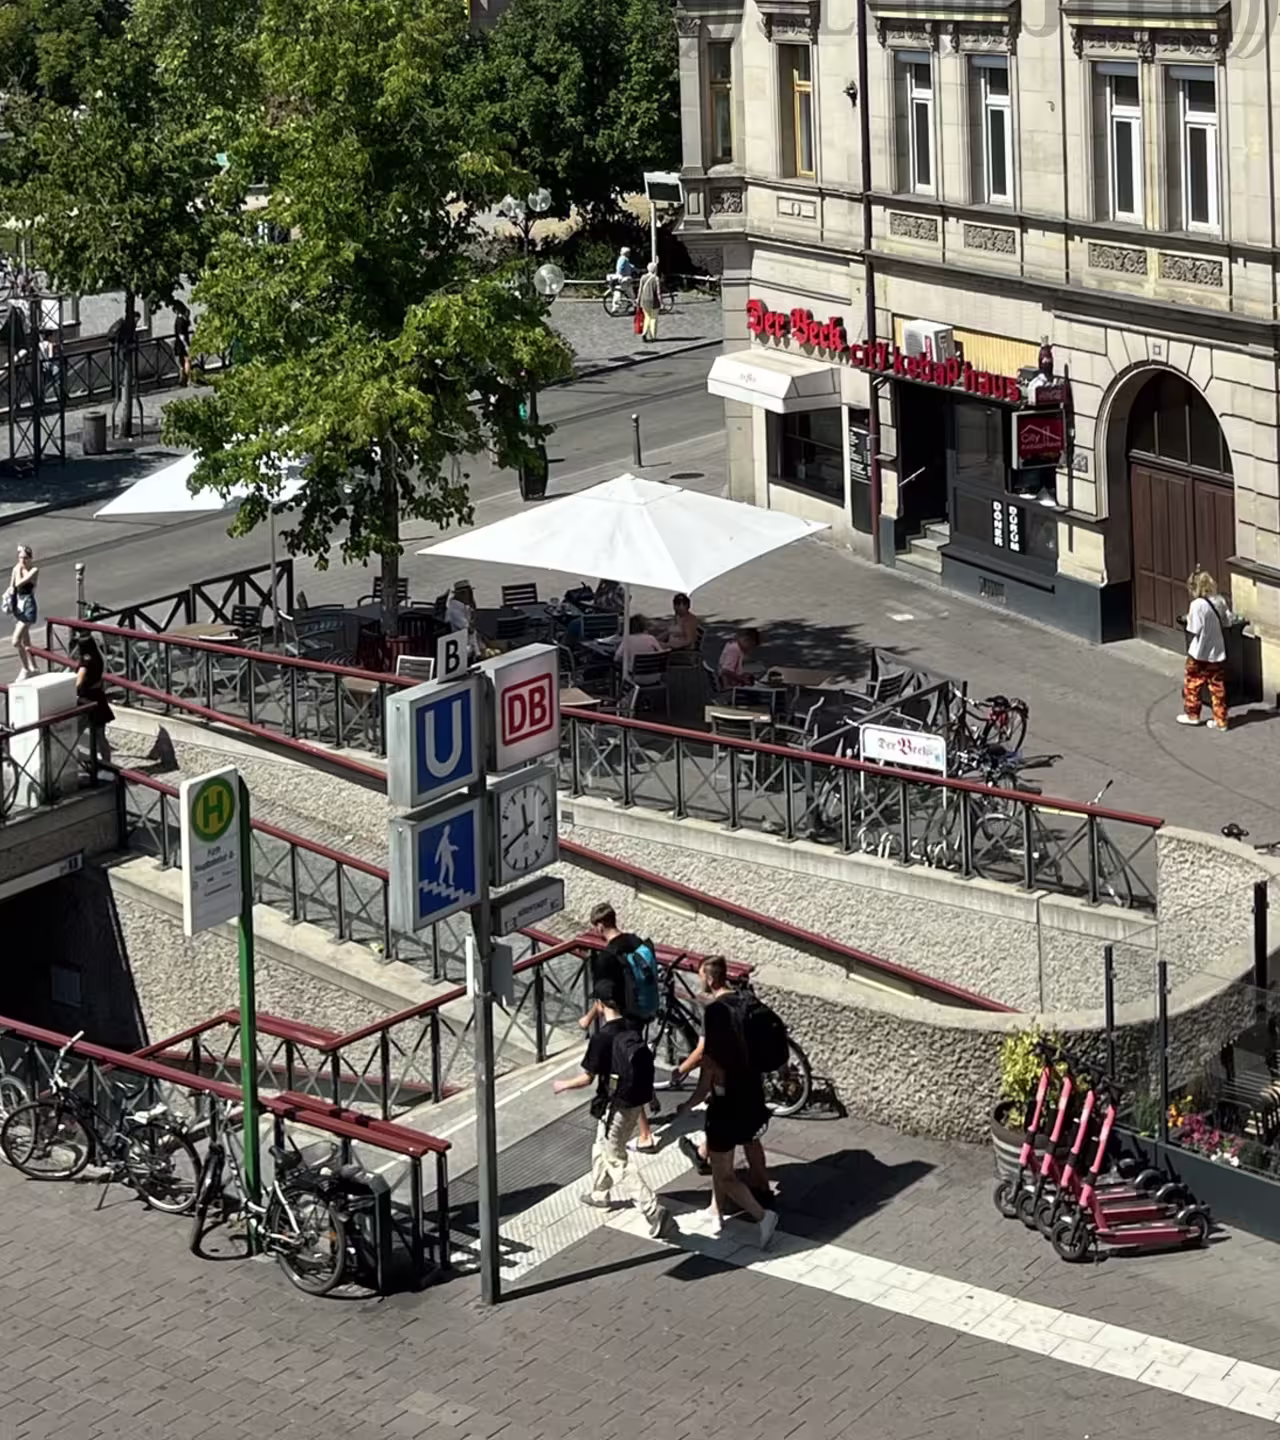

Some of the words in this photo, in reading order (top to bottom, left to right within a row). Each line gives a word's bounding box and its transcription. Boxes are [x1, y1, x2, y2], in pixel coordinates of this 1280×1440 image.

[747, 299, 786, 339] Der
[445, 639, 461, 675] B
[507, 684, 548, 737] DB
[424, 698, 463, 778] U
[201, 789, 225, 830] H
